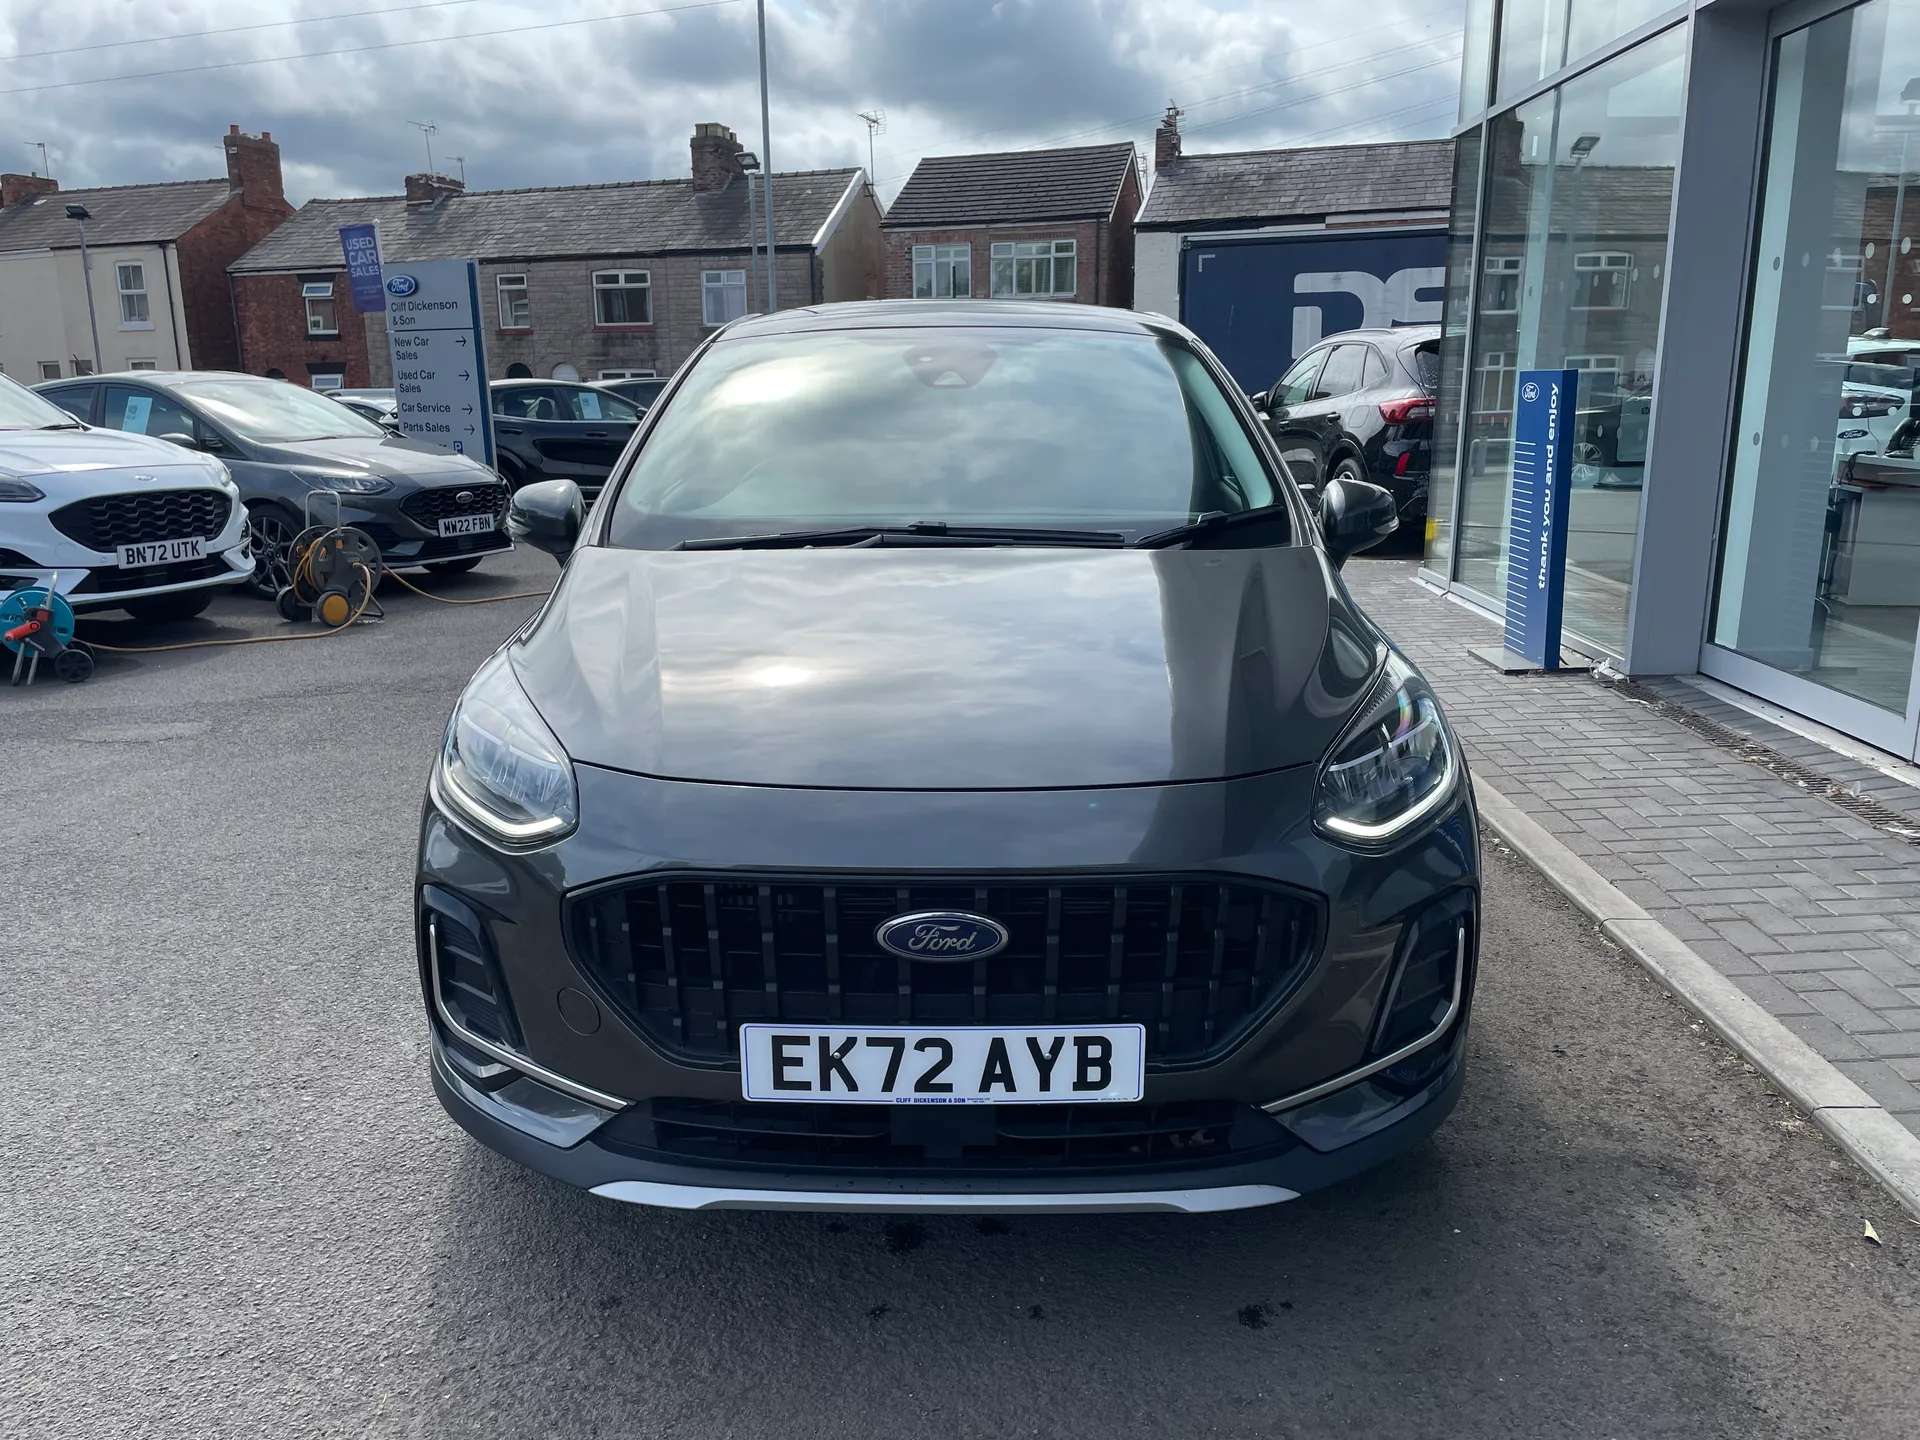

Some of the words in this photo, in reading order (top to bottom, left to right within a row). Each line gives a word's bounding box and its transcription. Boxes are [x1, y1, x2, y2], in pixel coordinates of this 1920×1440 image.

[346, 237, 374, 250] USED
[349, 250, 378, 265] CAR
[351, 265, 380, 277] SALES
[391, 278, 409, 292] Ford
[390, 301, 408, 314] Cliff
[408, 299, 458, 312] Dickenson
[392, 317, 399, 326] &
[400, 316, 416, 326] Son
[394, 337, 412, 347] New
[414, 337, 429, 347] Car
[396, 350, 418, 360] Sales
[398, 370, 418, 380] Used
[420, 370, 435, 380] Car
[399, 383, 421, 393] Sales
[402, 403, 416, 413] Car
[417, 402, 451, 413] Service
[1548, 382, 1558, 440] enjoy
[403, 423, 424, 433] Parts
[425, 422, 450, 433] Sales
[1545, 444, 1554, 485] and
[1543, 489, 1551, 527] you
[472, 516, 491, 531] FBN
[125, 544, 168, 564] BN72
[171, 540, 200, 559] UTK
[1538, 530, 1549, 589] thank
[908, 923, 977, 951] Ford
[771, 1035, 954, 1093] EK72
[978, 1035, 1113, 1093] AYB
